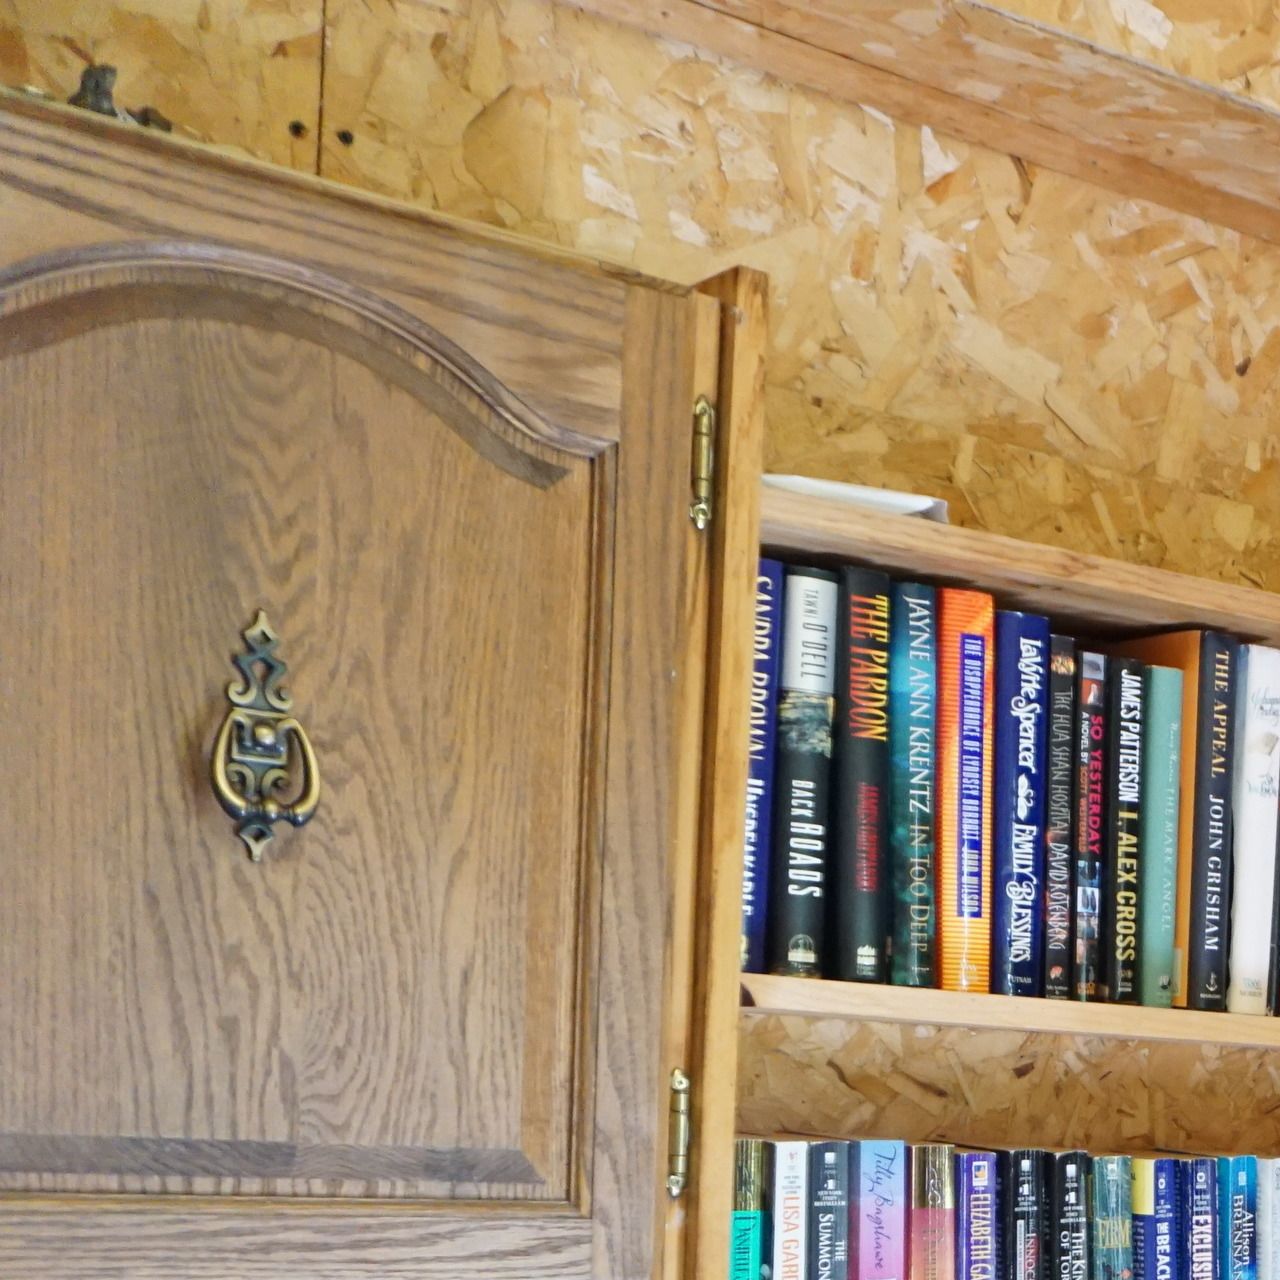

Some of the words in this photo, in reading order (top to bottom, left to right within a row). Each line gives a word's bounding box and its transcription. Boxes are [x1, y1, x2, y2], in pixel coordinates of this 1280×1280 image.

[851, 594, 890, 643] THE
[903, 595, 931, 661] JAYNE
[850, 646, 890, 742] PARDON
[908, 670, 931, 719] ANN
[1120, 669, 1143, 719] JAMES
[1213, 651, 1230, 693] THE
[1090, 714, 1104, 740] SO
[1210, 704, 1229, 778] APPEAL
[908, 726, 931, 813] KRENTZ
[1118, 721, 1141, 803] PATTERSON
[790, 779, 817, 818] BACK
[1087, 751, 1104, 854] YESTERDAY
[1208, 795, 1225, 849] JOHN
[787, 821, 826, 898] ROADS
[909, 825, 930, 848] IN
[1117, 831, 1138, 884] ALEX
[908, 857, 930, 897] TOO
[908, 904, 930, 952] DEEP
[1115, 891, 1137, 961] CROSS
[1204, 857, 1223, 951] GRISHAM
[782, 1197, 801, 1233] LISA
[970, 1193, 992, 1259] ELIZABETH
[1060, 1231, 1070, 1250] OF
[1072, 1229, 1085, 1252] THE
[1241, 1210, 1255, 1265] Allison
[834, 1239, 846, 1262] THE
